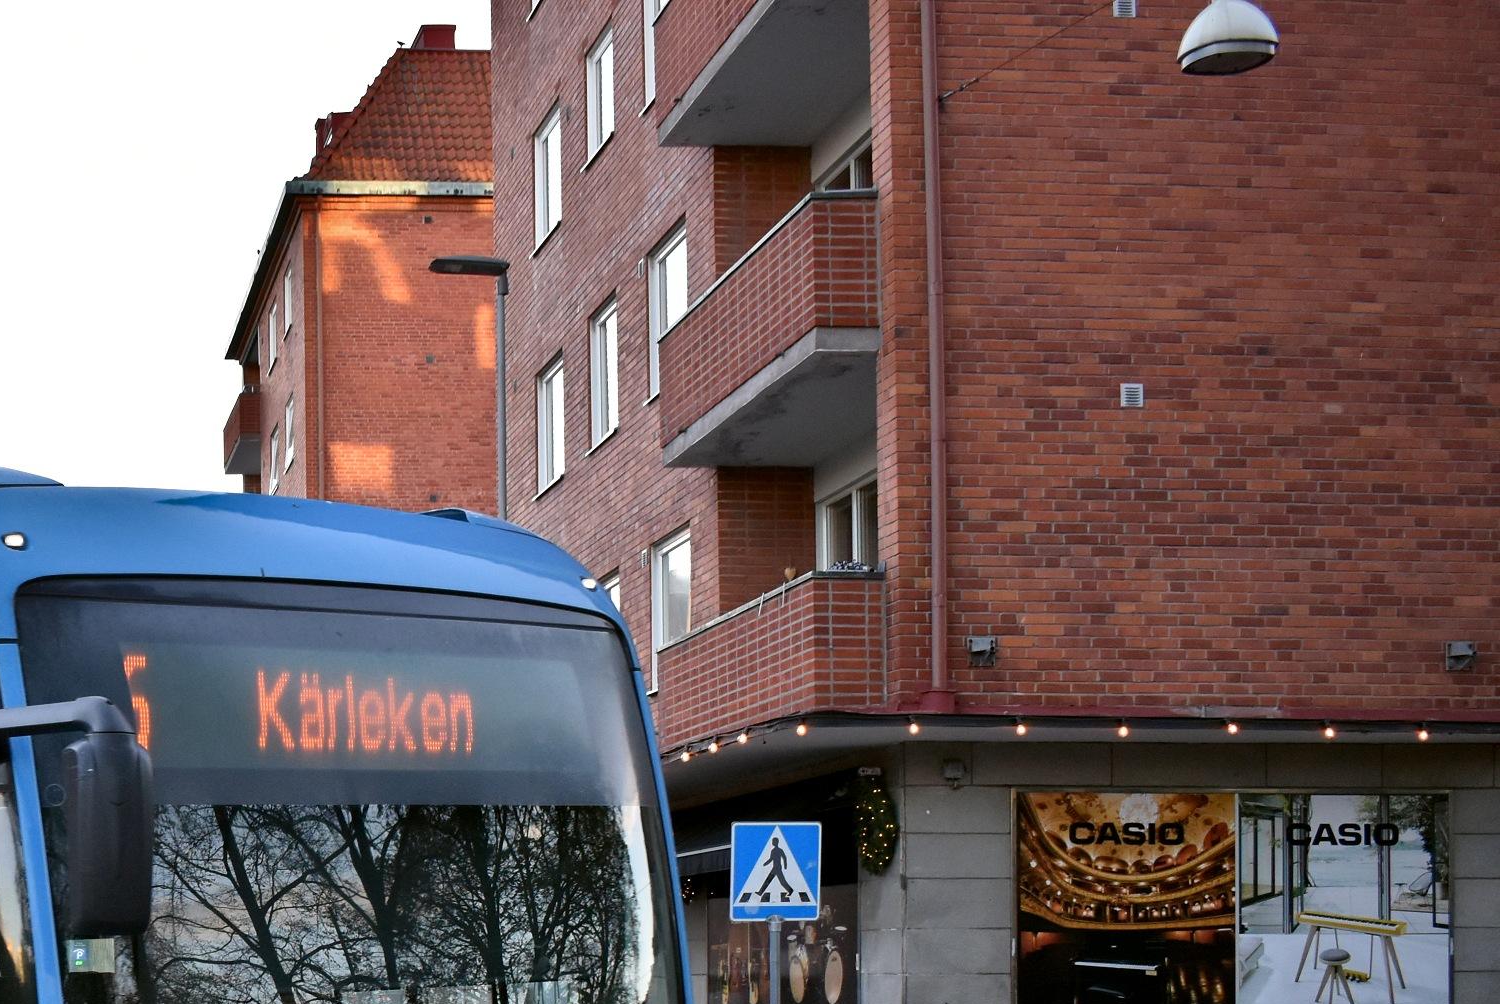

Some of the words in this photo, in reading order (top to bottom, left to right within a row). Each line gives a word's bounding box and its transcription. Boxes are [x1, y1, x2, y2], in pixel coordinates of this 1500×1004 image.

[257, 670, 474, 752] Kärleken
[1068, 822, 1185, 846] CASIO
[1286, 823, 1400, 847] CASIO
